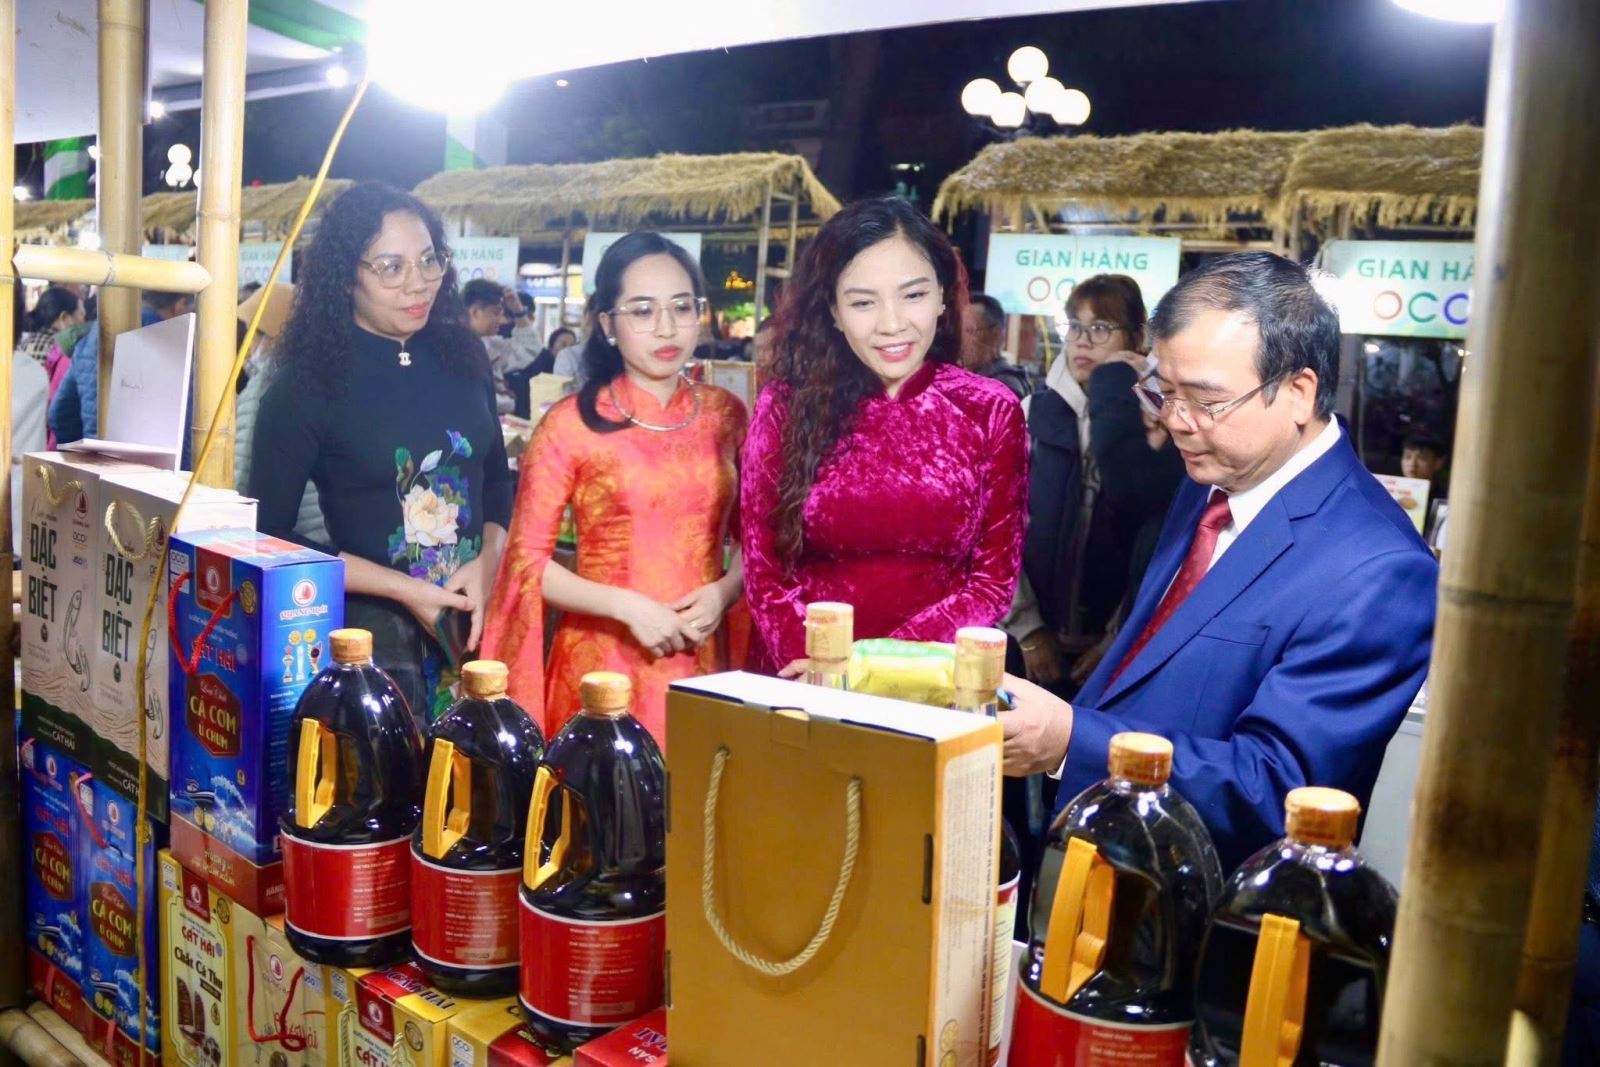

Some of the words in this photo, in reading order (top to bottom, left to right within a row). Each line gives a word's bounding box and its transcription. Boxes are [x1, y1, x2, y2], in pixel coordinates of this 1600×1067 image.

[1016, 250, 1072, 268] GIAN
[1081, 247, 1149, 270] HÀNG
[1358, 259, 1429, 280] GIAN
[30, 521, 57, 571] ĐẶC
